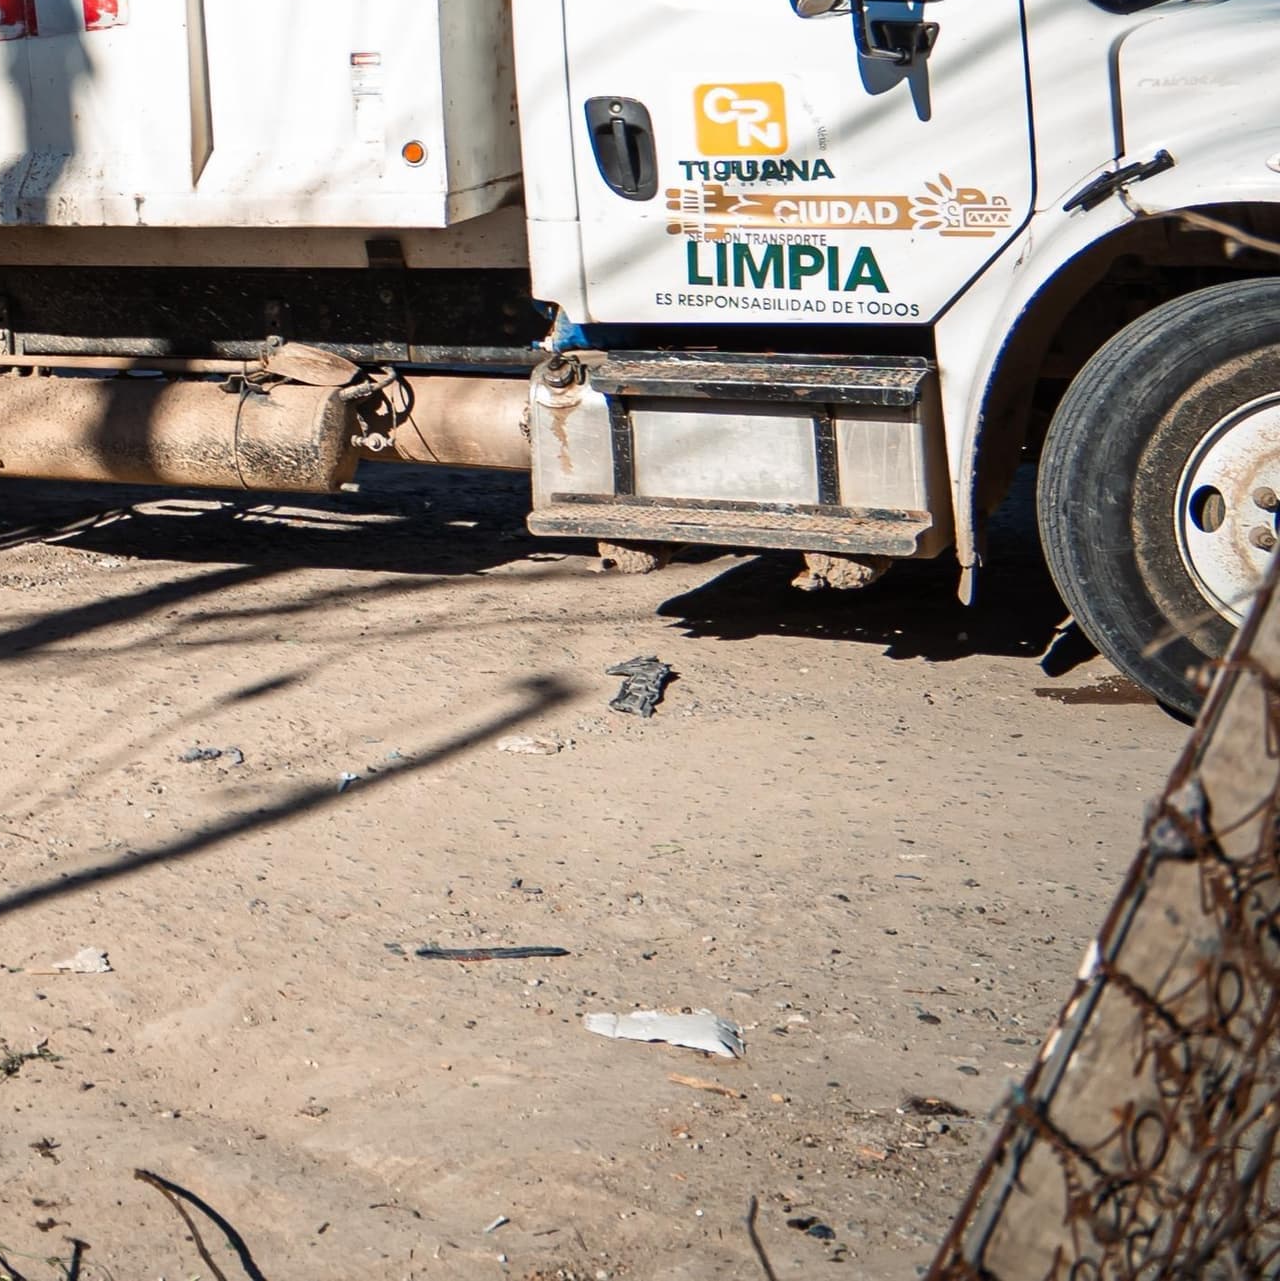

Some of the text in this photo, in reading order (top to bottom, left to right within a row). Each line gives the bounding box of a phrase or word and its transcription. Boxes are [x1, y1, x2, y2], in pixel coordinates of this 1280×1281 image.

[679, 158, 835, 182] TIJUANA
[773, 200, 899, 225] CIUDAD
[745, 233, 828, 247] TRANSPORTE
[687, 241, 890, 294] LIMPIA
[656, 293, 920, 317] ES RESPONSABILIDAD DE TODOS
